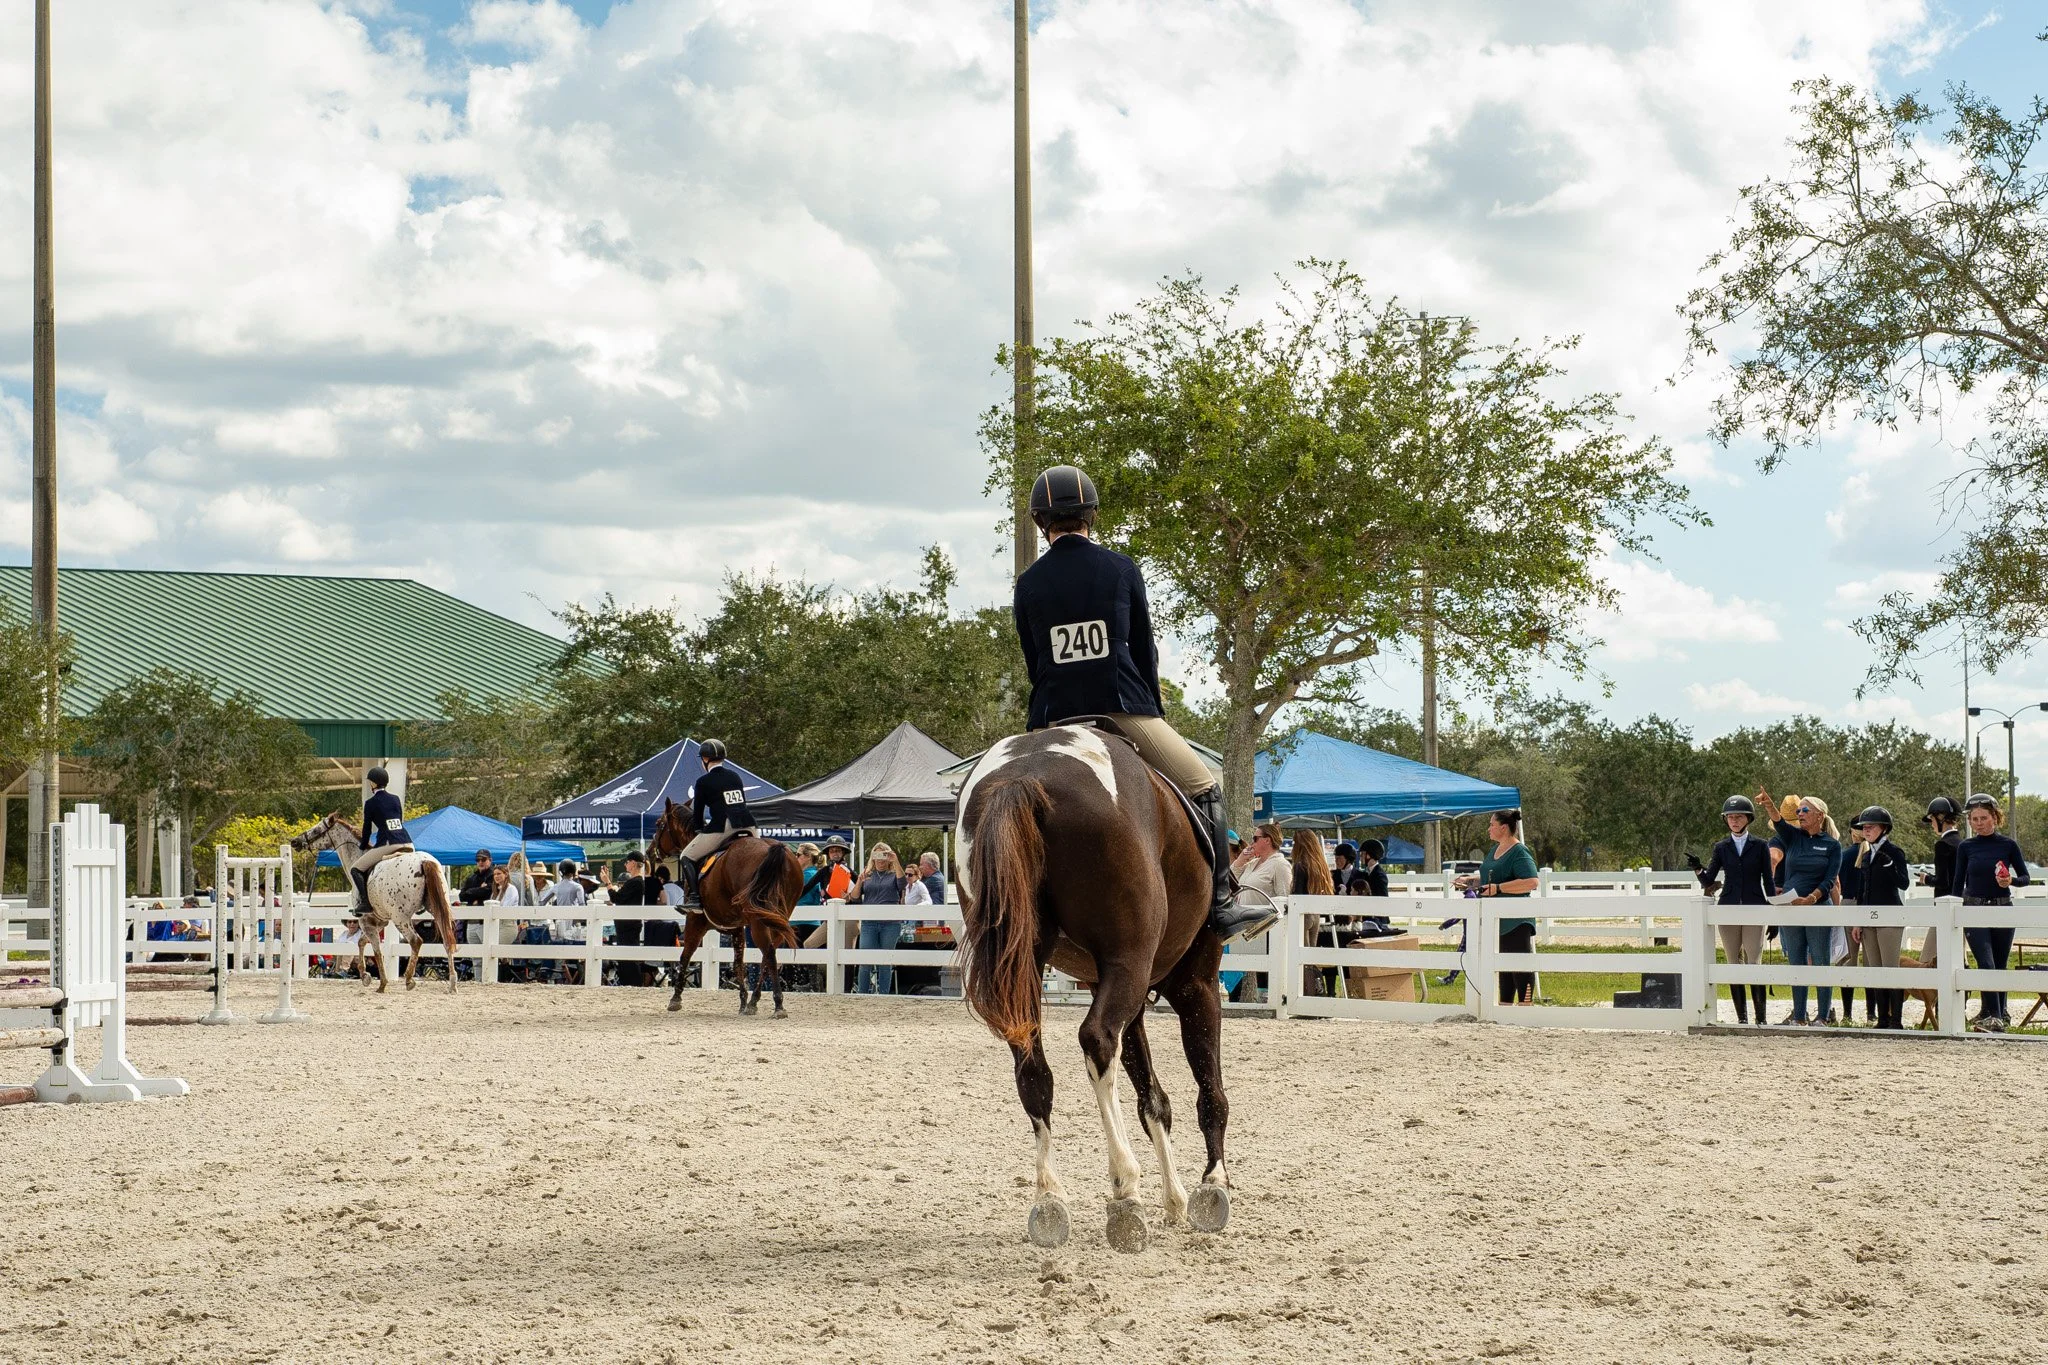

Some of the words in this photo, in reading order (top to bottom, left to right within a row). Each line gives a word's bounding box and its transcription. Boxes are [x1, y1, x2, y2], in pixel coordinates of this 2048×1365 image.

[1057, 623, 1104, 660] 240
[726, 791, 743, 803] 242
[388, 819, 401, 829] 234
[1415, 901, 1423, 910] 20
[1870, 910, 1879, 920] 25
